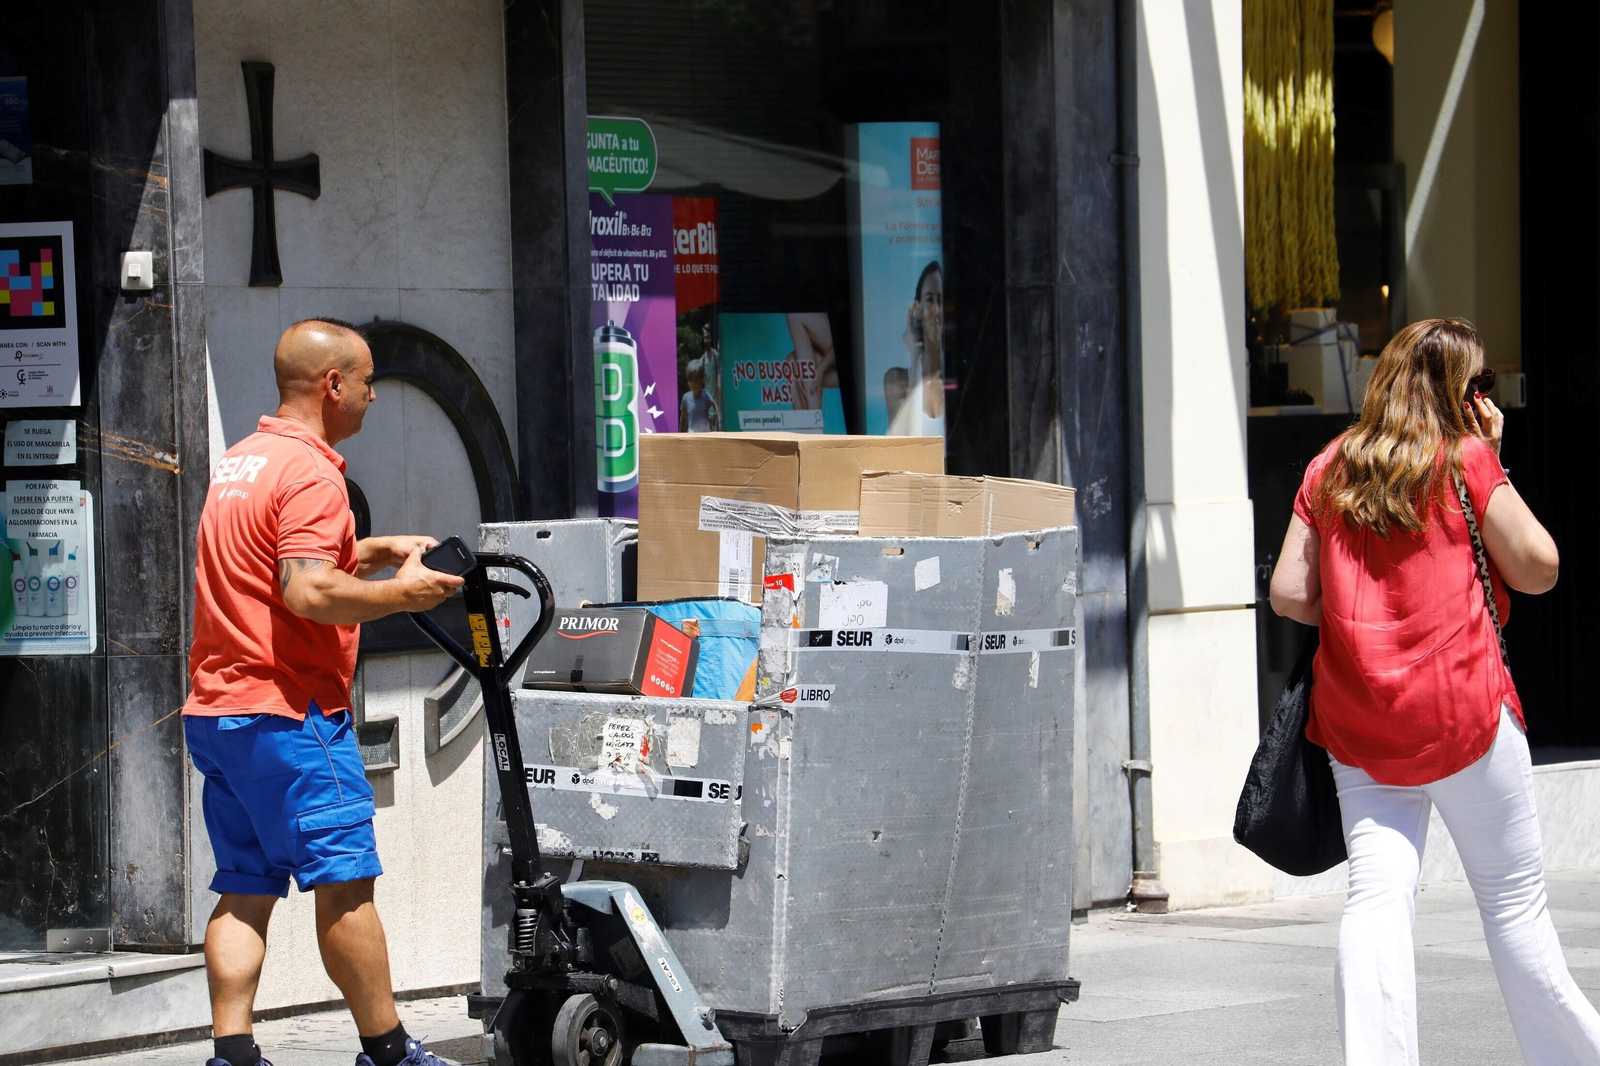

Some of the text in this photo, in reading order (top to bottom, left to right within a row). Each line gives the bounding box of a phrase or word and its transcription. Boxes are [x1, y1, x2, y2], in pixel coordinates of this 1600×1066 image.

[622, 139, 628, 151] a
[629, 137, 639, 151] tu
[587, 152, 649, 174] MACÉUTICO!
[591, 263, 649, 282] UPERA TU
[682, 264, 691, 273] LO
[692, 264, 704, 275] QUE
[591, 283, 640, 302] TALIDAD
[733, 361, 816, 388] ¡NO BUSQUES
[762, 379, 793, 403] MÁS!
[558, 616, 619, 631] PRIMOR
[29, 630, 54, 638] prevenir
[836, 630, 873, 647] SEUR
[984, 634, 1006, 650] SEUR
[800, 689, 831, 701] LIBRO
[495, 734, 509, 771] LOCAL
[660, 958, 681, 992] LOCAL
